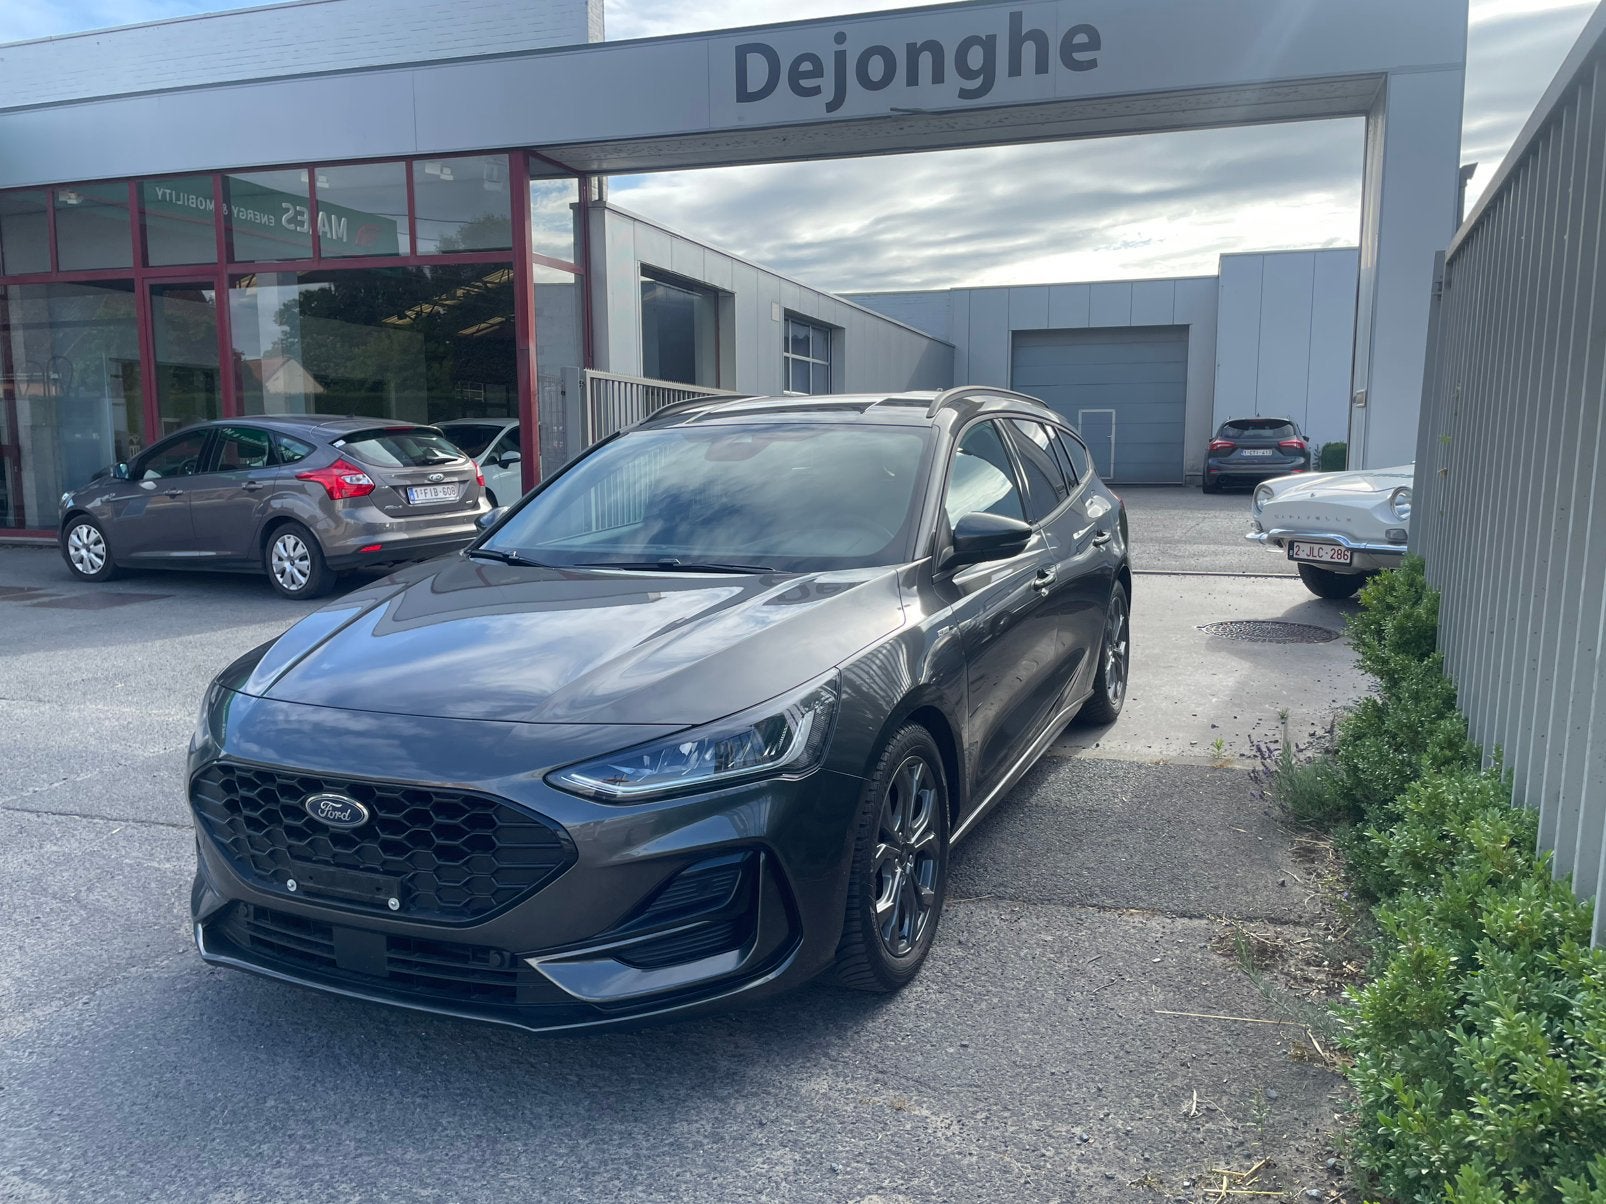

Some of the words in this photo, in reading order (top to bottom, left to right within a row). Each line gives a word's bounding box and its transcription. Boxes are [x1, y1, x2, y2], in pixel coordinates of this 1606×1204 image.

[735, 11, 1101, 113] Dejonghe
[1294, 544, 1350, 561] 2-JLC-286
[318, 801, 351, 820] Ford
